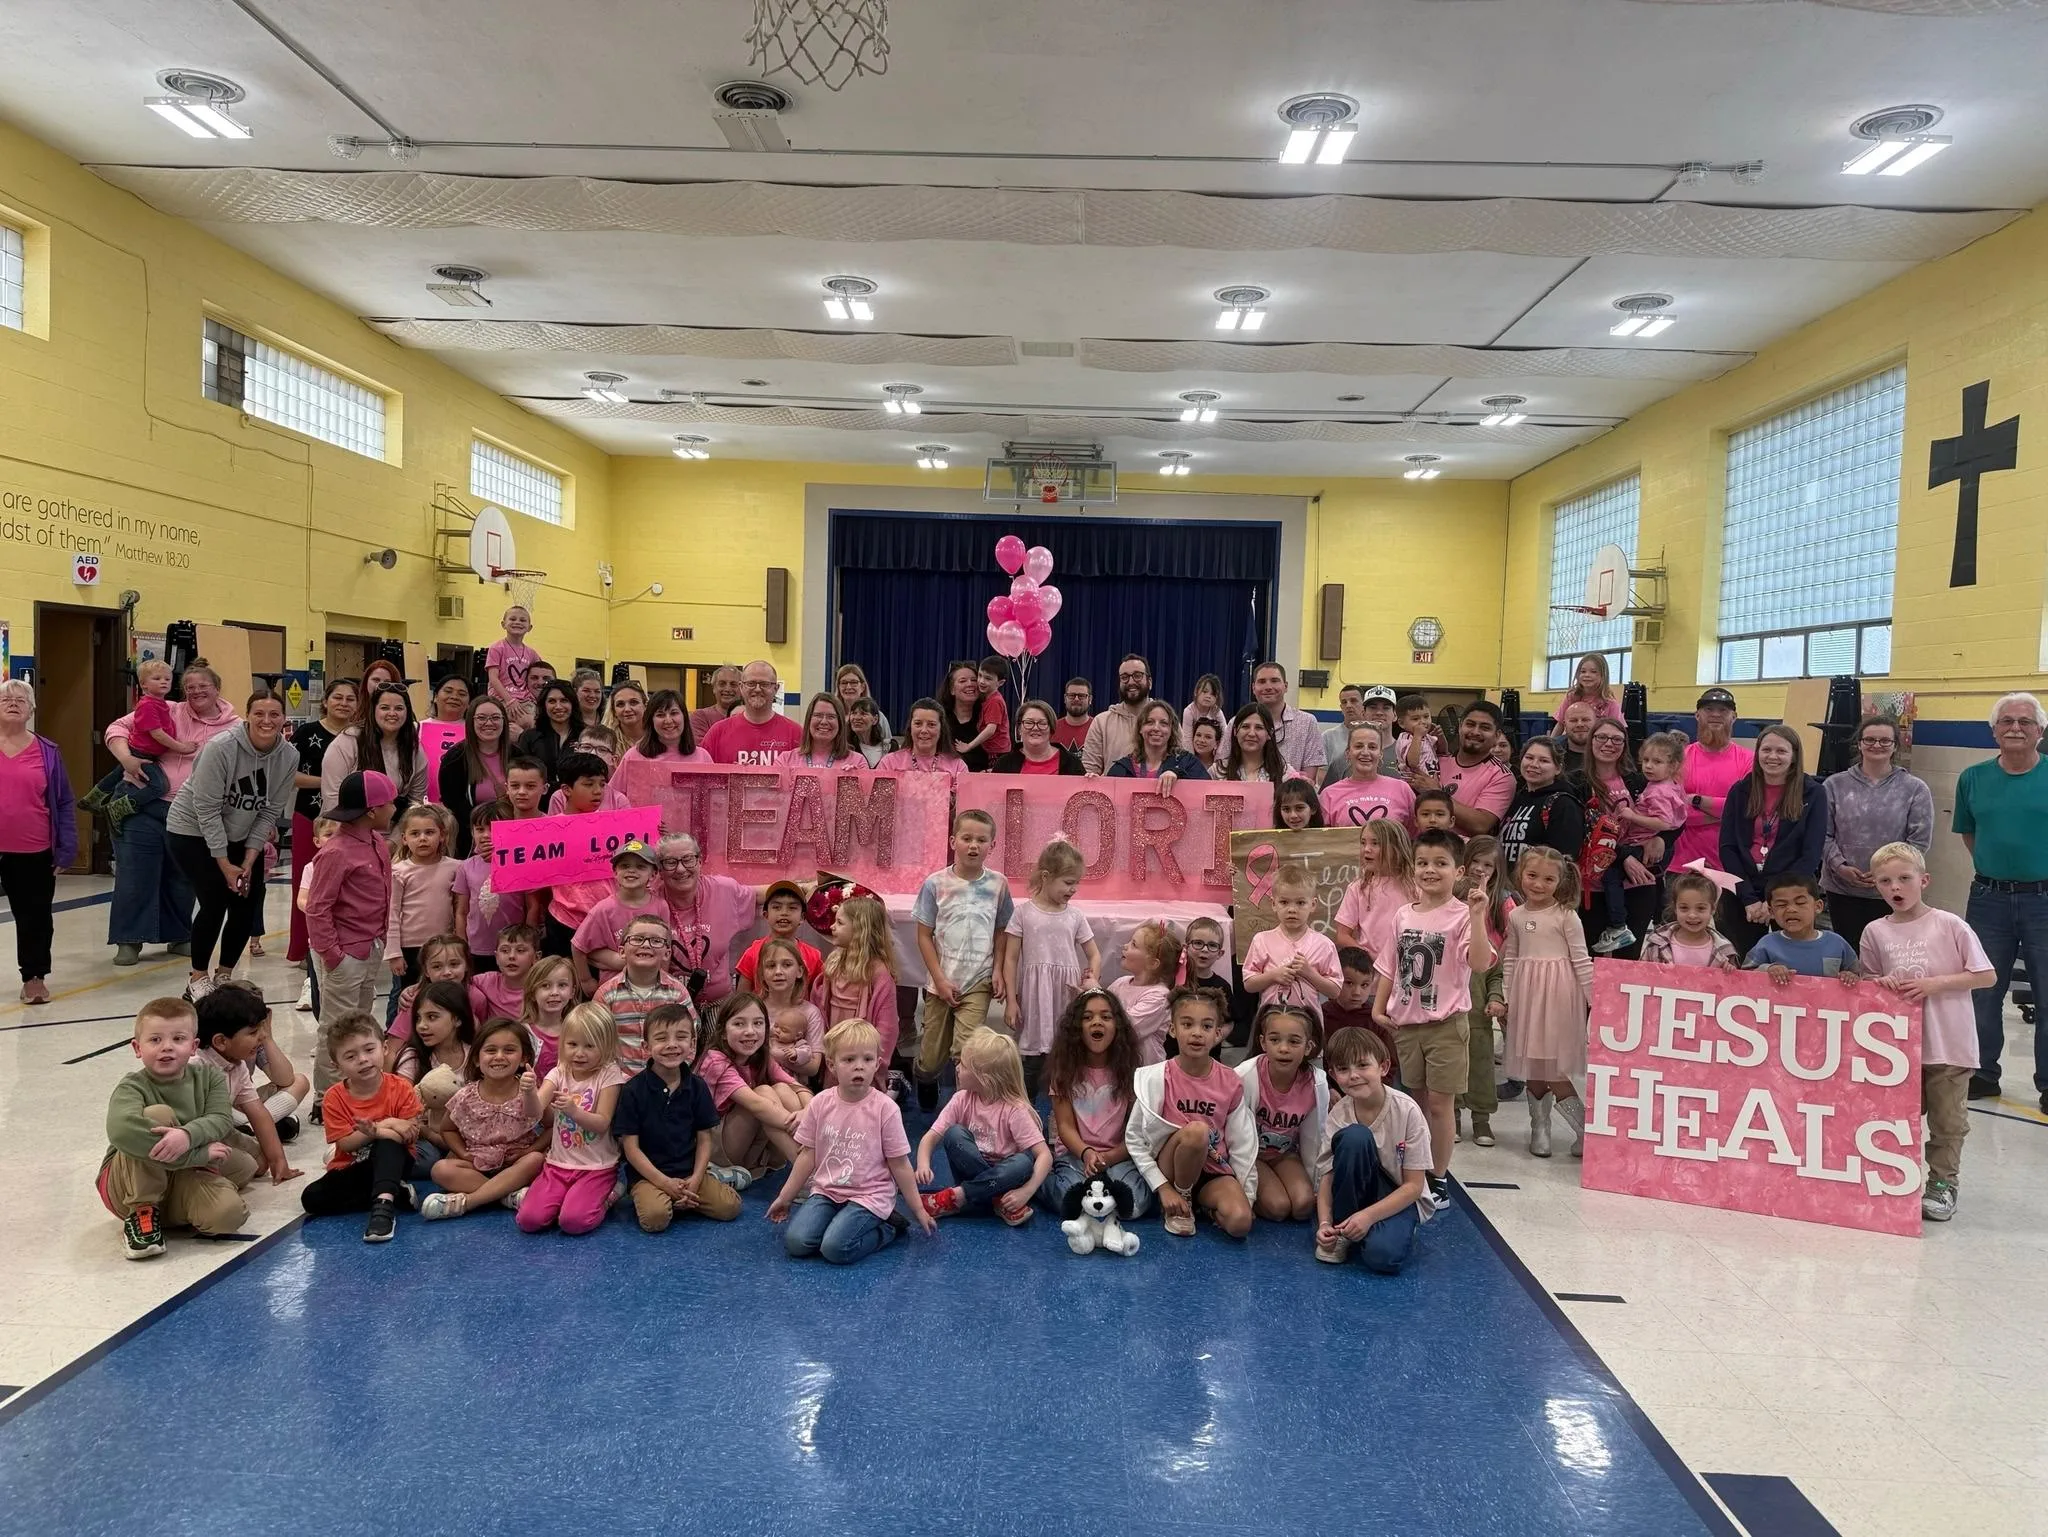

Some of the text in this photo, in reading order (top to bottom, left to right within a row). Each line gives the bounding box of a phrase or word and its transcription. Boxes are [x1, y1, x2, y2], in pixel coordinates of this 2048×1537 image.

[3, 491, 201, 547] are gathered in my name,
[36, 524, 55, 546] of
[76, 555, 99, 565] AED
[115, 542, 164, 565] Matthew
[673, 629, 691, 639] EXIT
[1415, 651, 1433, 662] EXIT
[671, 771, 1245, 886] TEAM LORI
[496, 841, 565, 866] TEAM
[590, 832, 650, 853] LORI
[1600, 983, 1909, 1087] JESUS
[1177, 1099, 1216, 1116] ALISE
[824, 1124, 867, 1140] Mrs. Lori
[1584, 1063, 1922, 1197] HEALS
